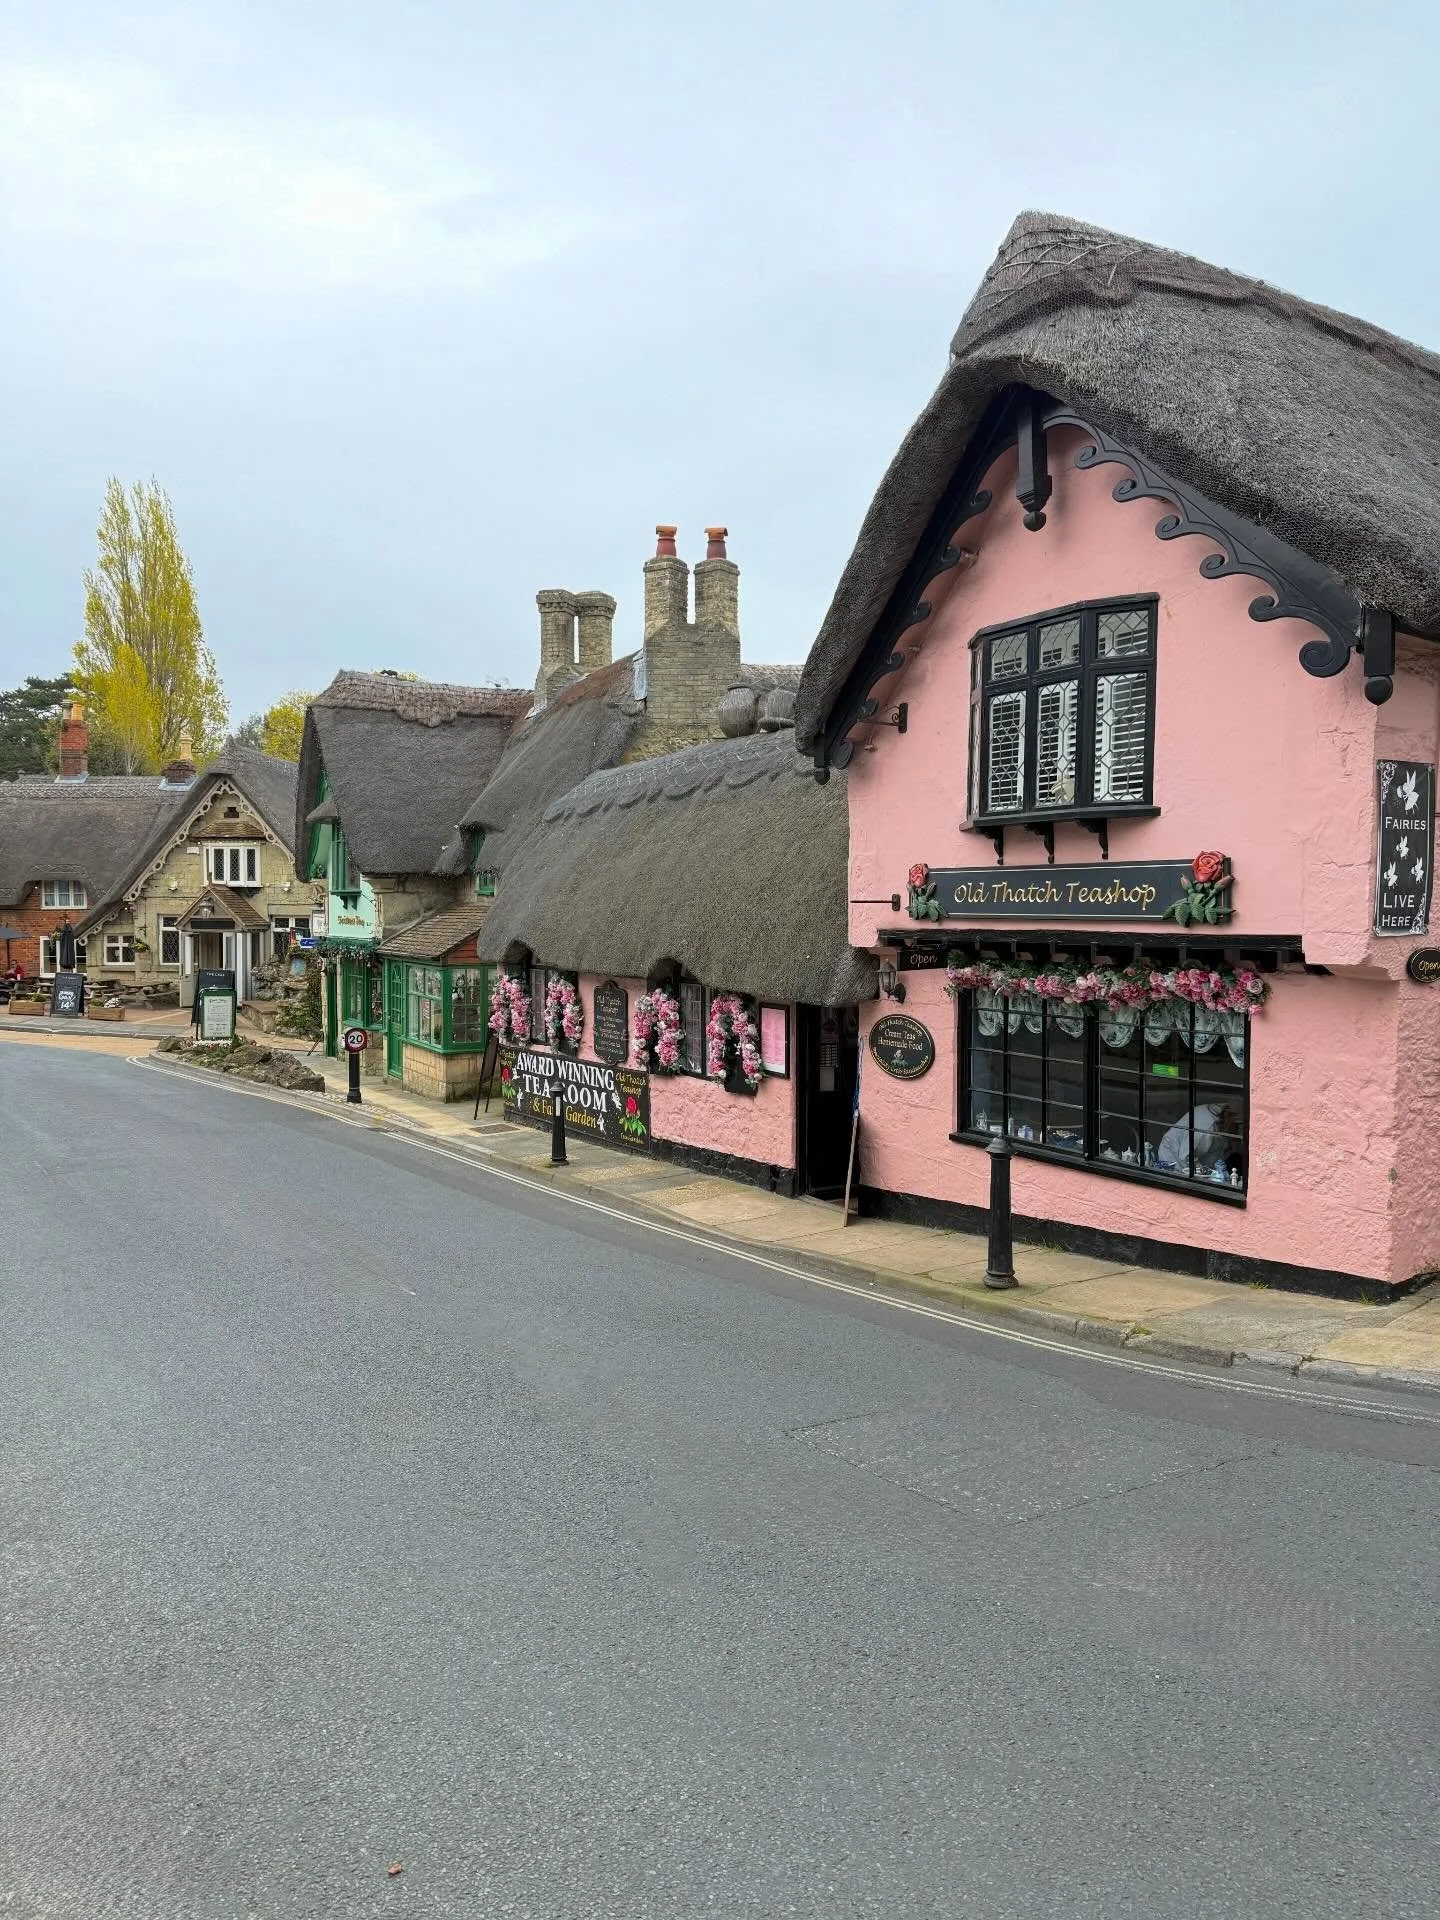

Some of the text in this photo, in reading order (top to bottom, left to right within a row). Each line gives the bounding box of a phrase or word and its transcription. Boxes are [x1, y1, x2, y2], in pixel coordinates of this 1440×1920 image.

[1385, 816, 1427, 830] FAIRIES
[954, 878, 1156, 911] Old Thatch Teashop
[1383, 892, 1415, 908] LIVE
[1381, 914, 1411, 927] HERE
[910, 953, 938, 967] Open
[350, 1034, 363, 1044] 20
[884, 1029, 916, 1041] Cream Teas
[877, 1036, 923, 1051] Homemade Food
[517, 1052, 614, 1091] AWARD WINNING
[522, 1073, 552, 1099] TEA
[626, 1073, 646, 1086] Thatch
[533, 1097, 541, 1113] &
[565, 1105, 597, 1129] Garden
